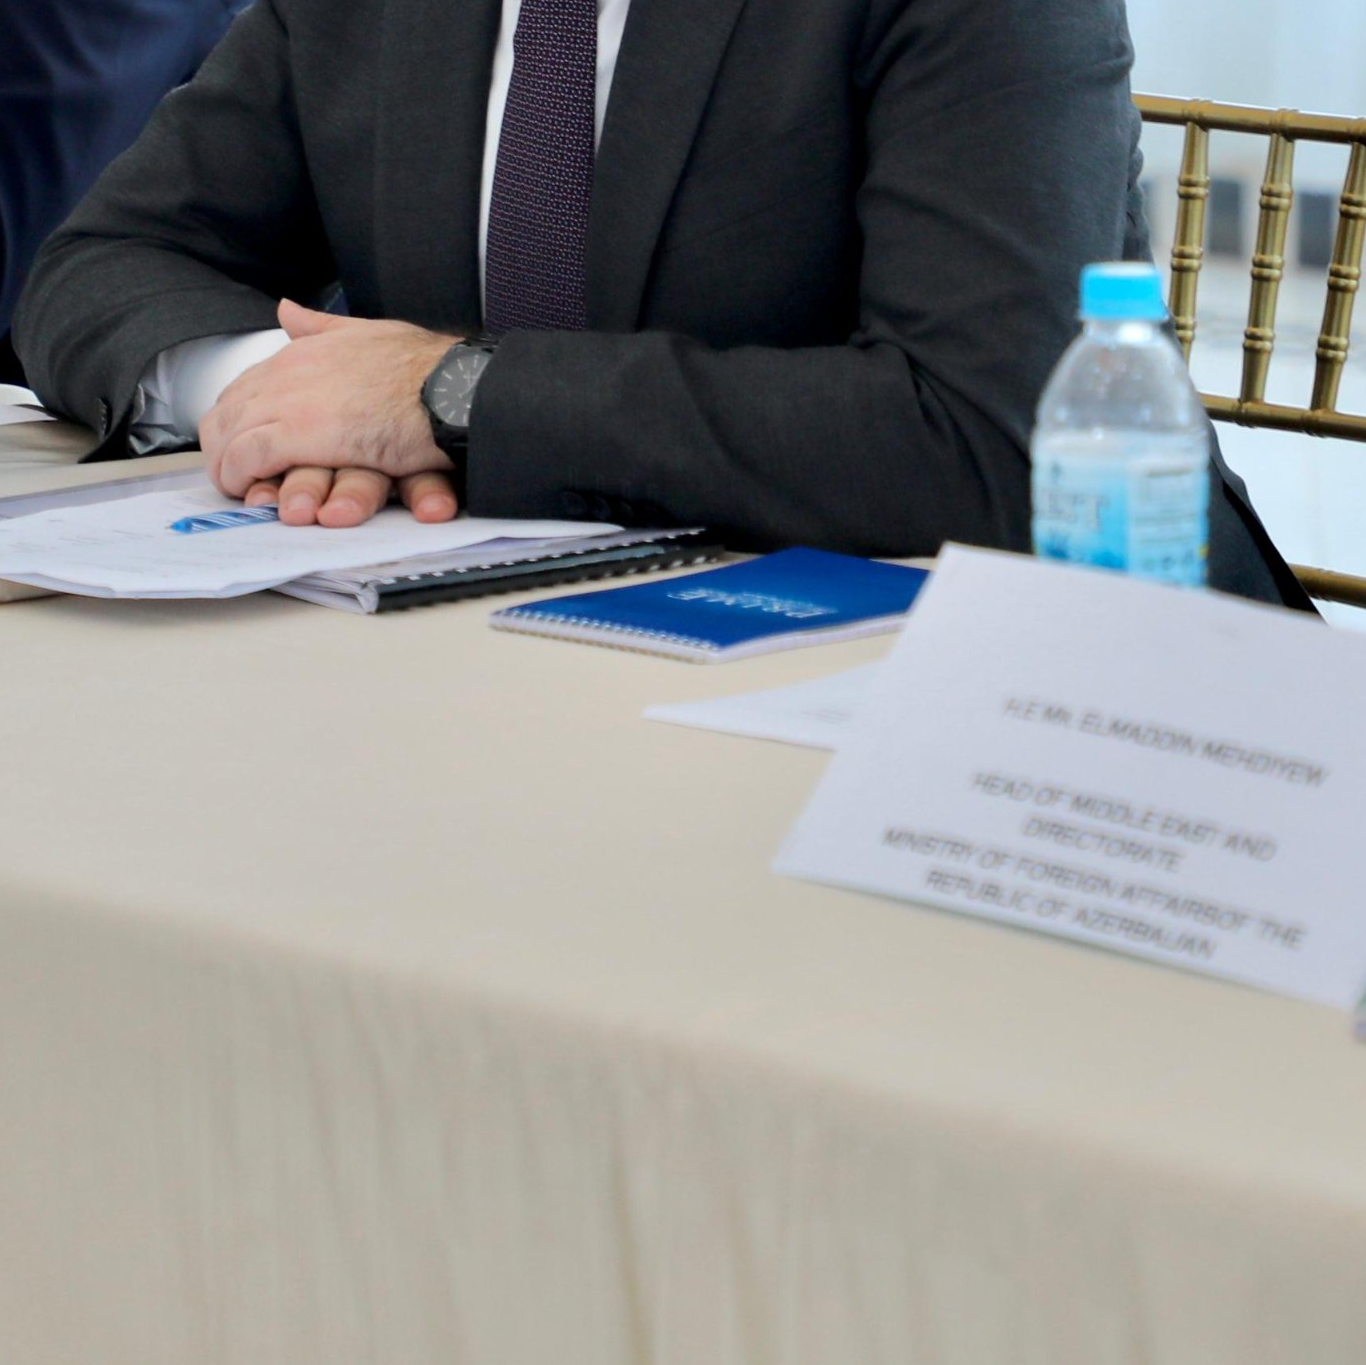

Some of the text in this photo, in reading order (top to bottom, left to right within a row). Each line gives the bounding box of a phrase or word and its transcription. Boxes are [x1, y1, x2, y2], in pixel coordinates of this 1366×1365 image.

[973, 772, 1278, 862] HEAD OF MIDDLE EAST AND
[1022, 816, 1185, 873] DIRECTORATE
[883, 828, 977, 863] MINISTRY
[979, 849, 1010, 869] OF
[1015, 857, 1115, 898] FOREIGN
[1258, 917, 1307, 950] THE
[925, 870, 1035, 912] REPUBLIC
[1037, 899, 1068, 917] OF
